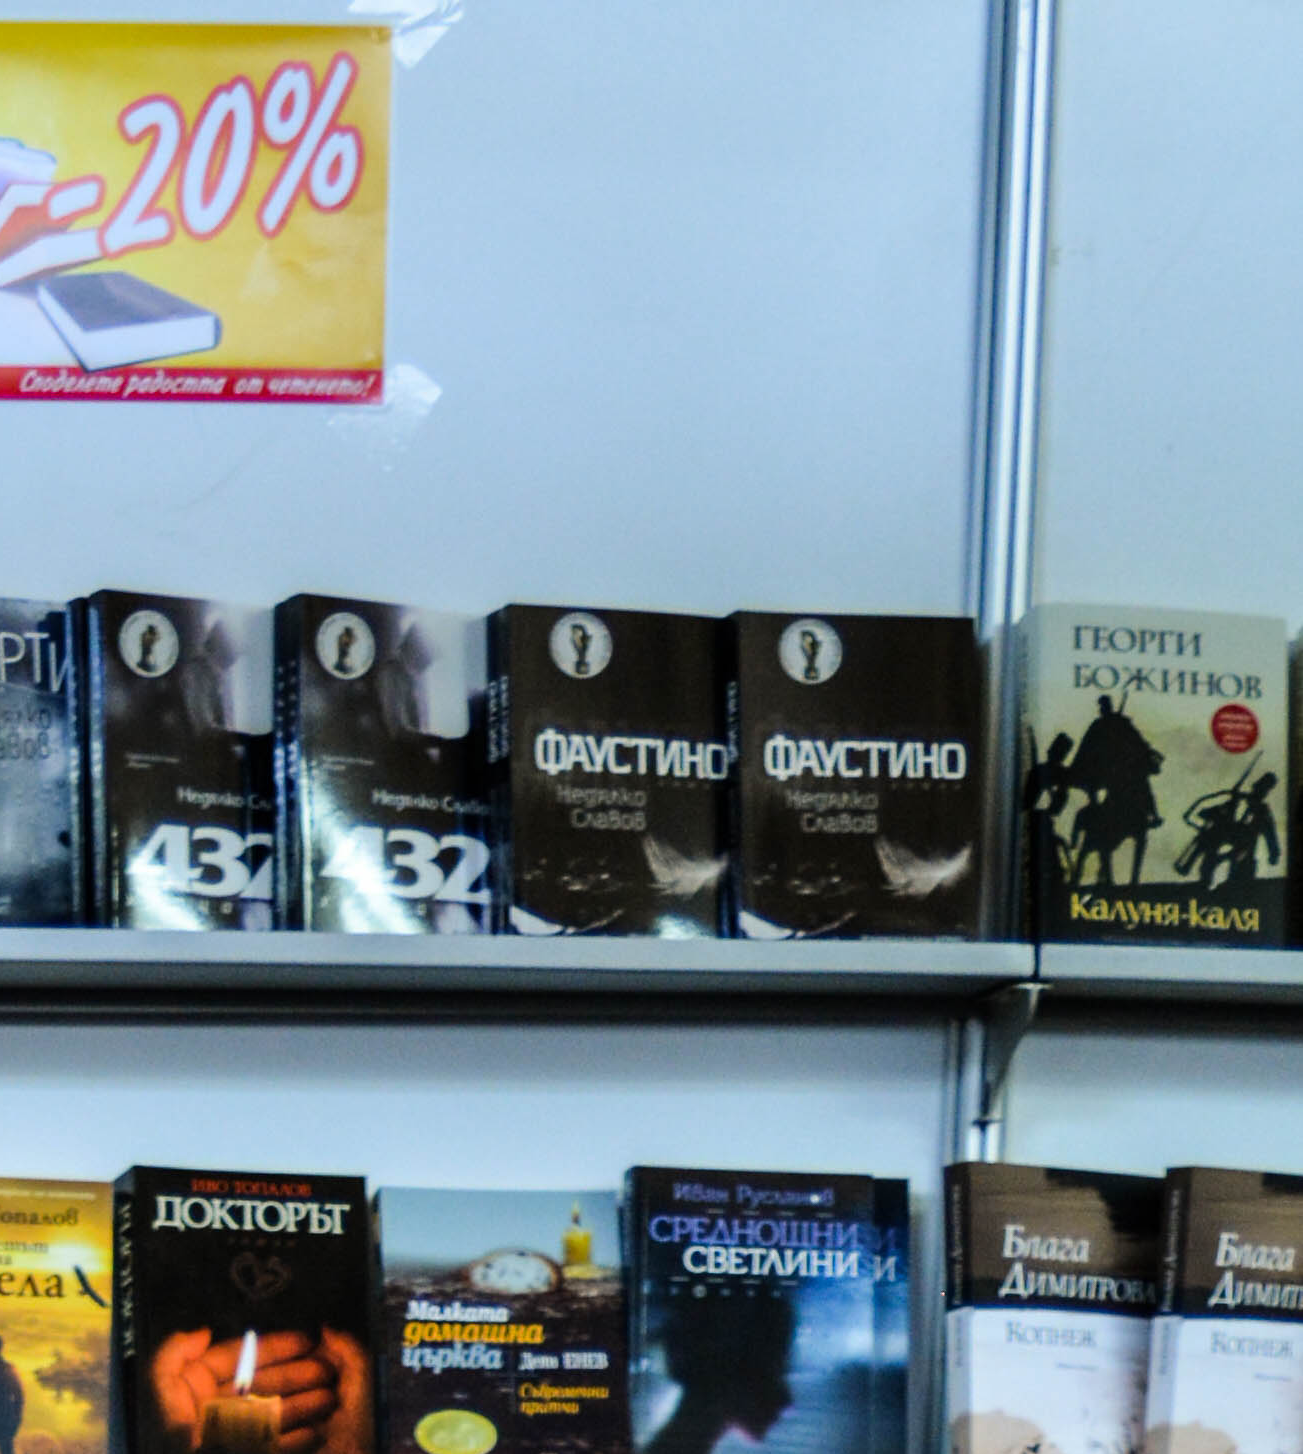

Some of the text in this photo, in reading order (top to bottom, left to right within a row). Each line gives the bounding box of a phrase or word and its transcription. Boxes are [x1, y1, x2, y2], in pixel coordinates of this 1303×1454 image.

[19, 369, 123, 395] Споделете
[234, 376, 264, 395] от
[1072, 625, 1203, 658] ГЕОРГИ
[1072, 664, 1263, 701] БОЖИНОВ
[764, 734, 967, 782] ФАУСТИНО
[800, 810, 877, 834] Славов
[1069, 892, 1260, 933] Калуня-каля
[152, 1195, 351, 1236] ДОКТОРЪТ
[648, 1215, 859, 1248] СРЕДНОЩНИ
[1003, 1223, 1090, 1264] Блага
[683, 1245, 861, 1279] СВЕТЛИНИ
[405, 1299, 511, 1324] Малката
[403, 1322, 544, 1347] домашна
[400, 1341, 503, 1374] църква
